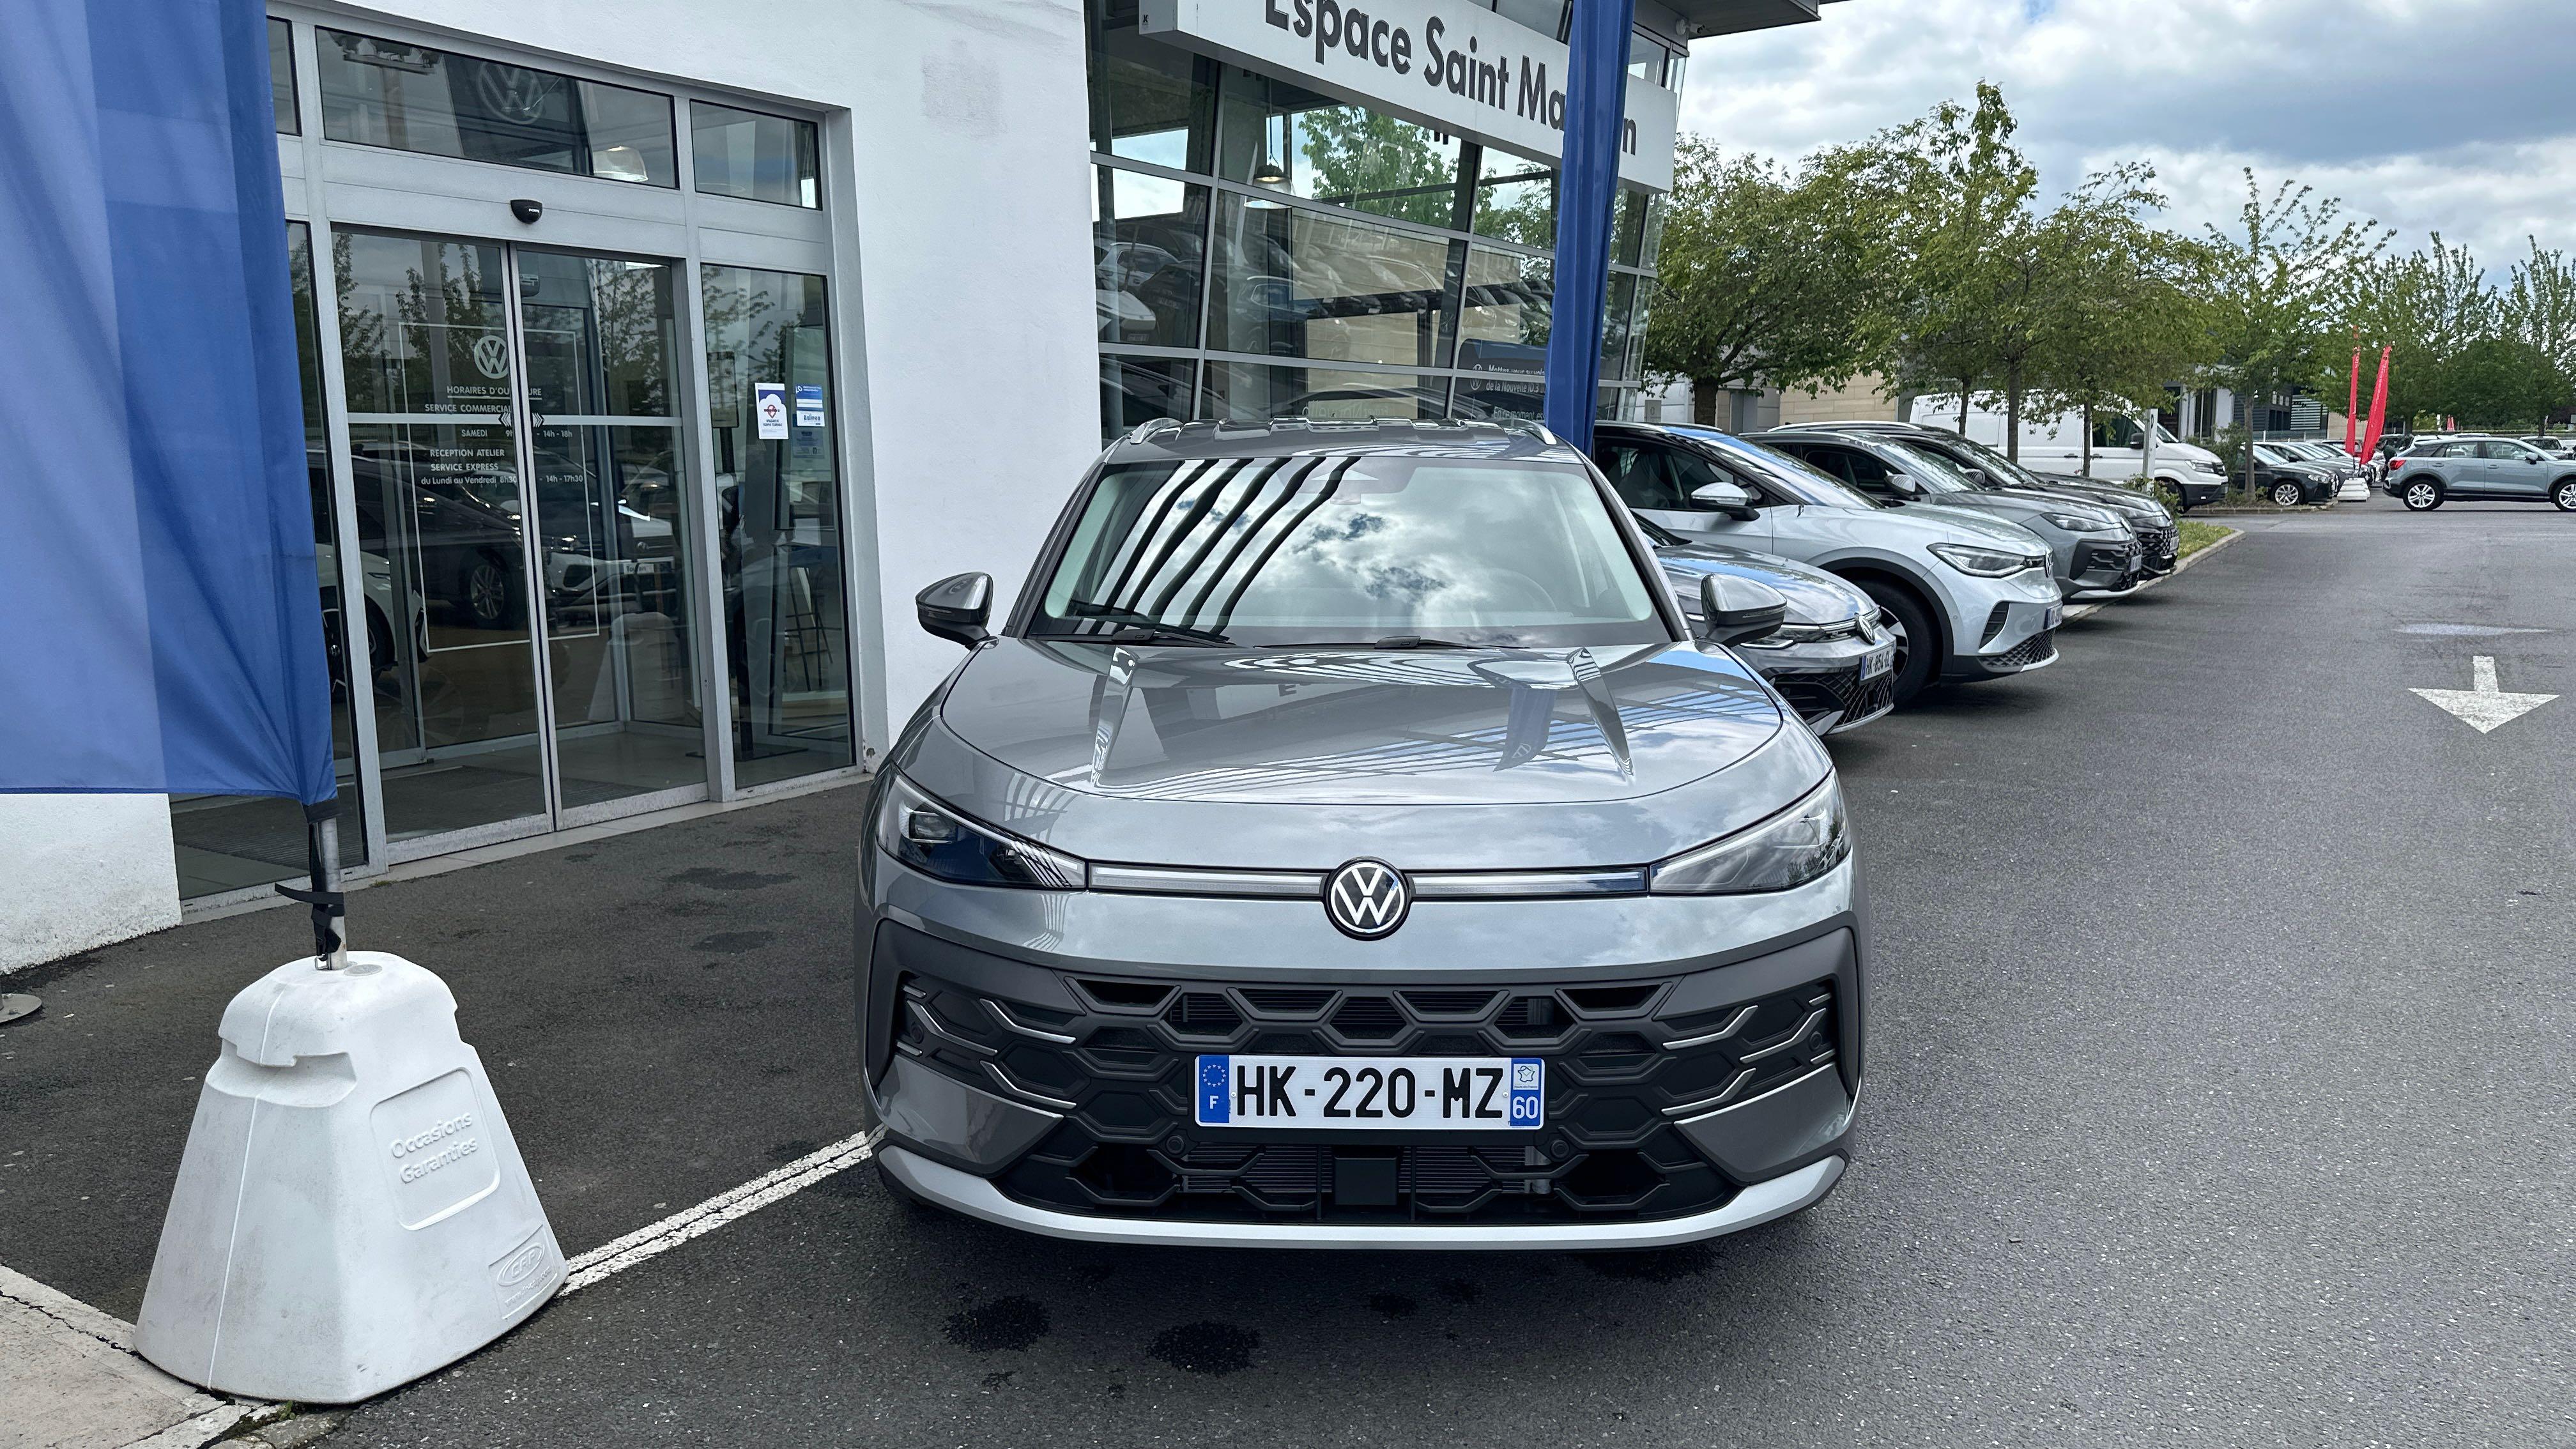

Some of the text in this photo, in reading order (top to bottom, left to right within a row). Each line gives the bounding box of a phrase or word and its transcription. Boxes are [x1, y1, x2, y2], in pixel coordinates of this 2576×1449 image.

[1423, 15, 1509, 111] Saint
[447, 385, 542, 396] HORAIRES D'OUURE
[1486, 381, 1494, 391] de
[1494, 381, 1501, 391] la
[1501, 381, 1527, 393] Nouvelle
[425, 404, 512, 413] SERVICE COMMERCIAL
[431, 463, 463, 471] SERVICE
[433, 477, 452, 485] Lundi
[465, 476, 496, 484] Vendredi
[1331, 861, 1404, 933] VW
[1209, 1065, 1538, 1119] F HK-220-MZ 60
[390, 1112, 473, 1158] Occasions
[399, 1137, 479, 1184] Garanties
